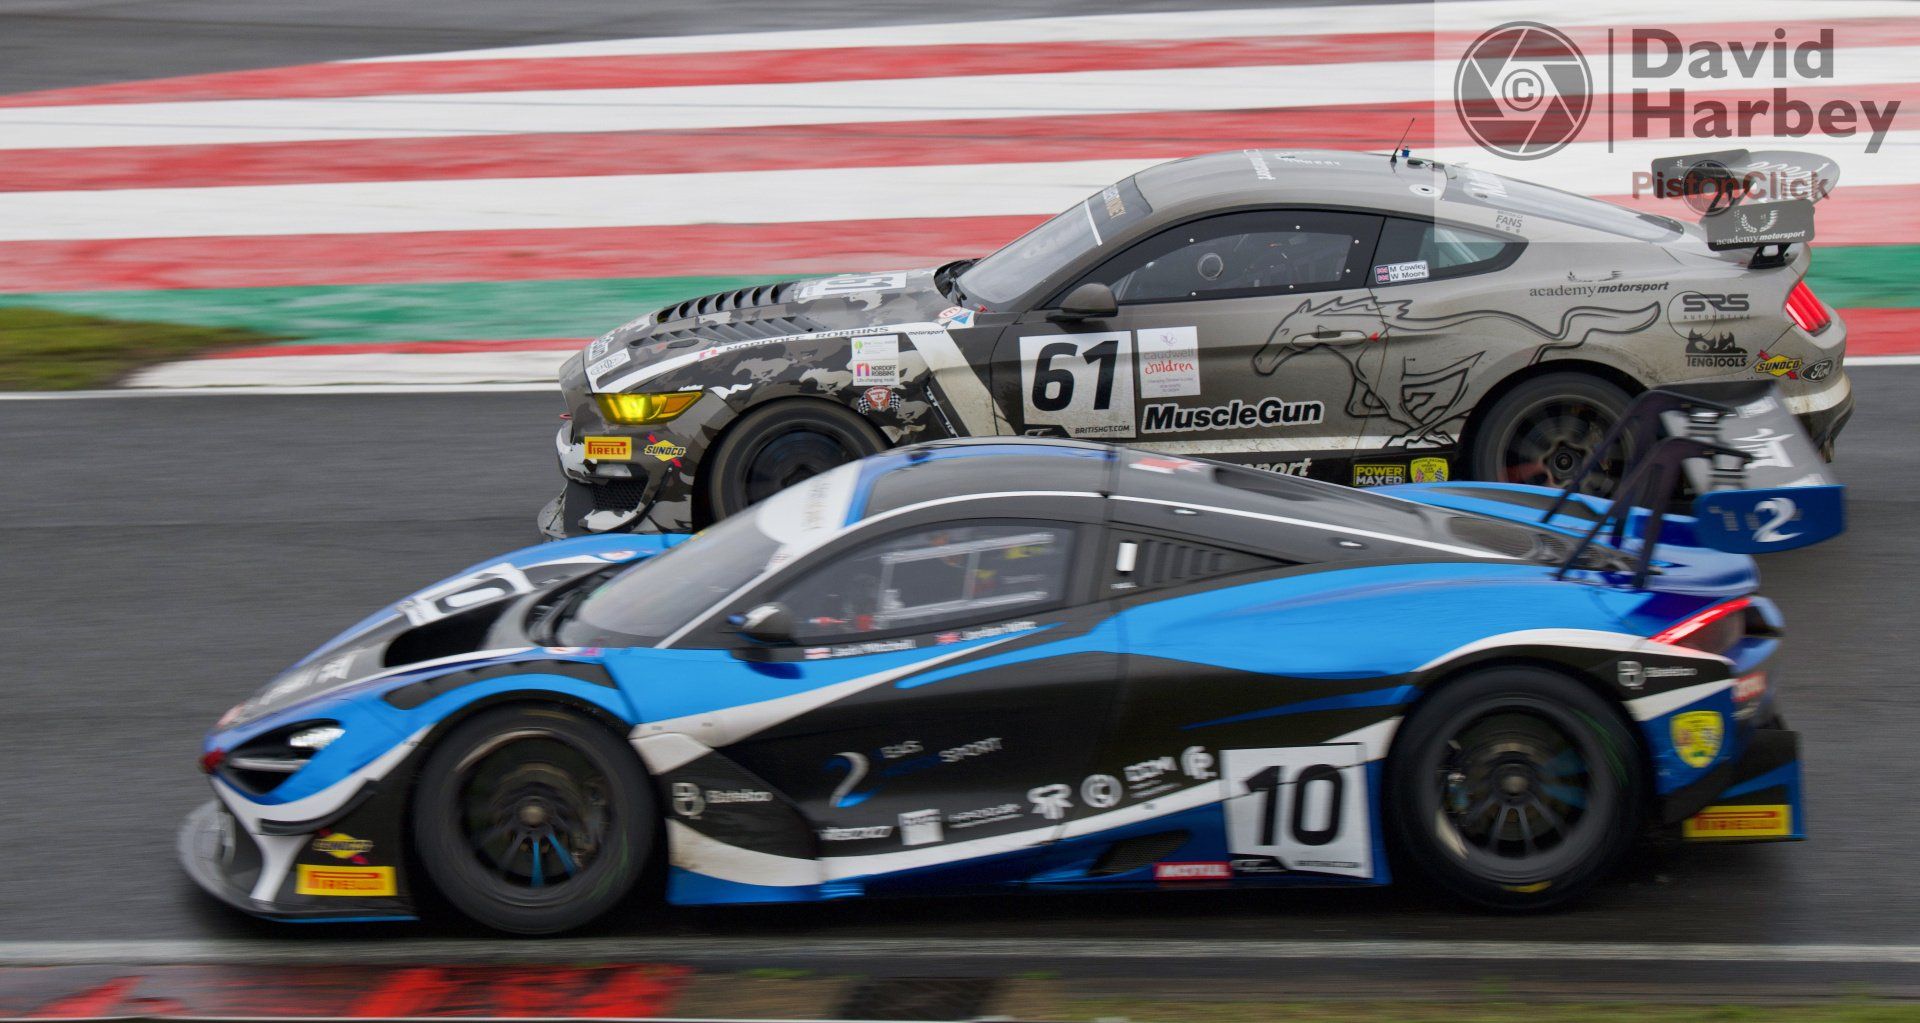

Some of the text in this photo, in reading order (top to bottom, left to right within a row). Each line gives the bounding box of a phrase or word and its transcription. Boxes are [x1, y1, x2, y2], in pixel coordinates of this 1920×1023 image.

[1496, 215, 1523, 228] FANS
[1683, 293, 1750, 312] SRS
[1144, 347, 1194, 359] caudwell
[1145, 360, 1194, 374] children
[1758, 360, 1801, 372] SUNOCO
[1811, 360, 1832, 379] Ford
[1032, 340, 1119, 412] 61
[1144, 399, 1322, 430] MuscleGun
[1075, 425, 1130, 434] BRITISHGT.COM
[588, 441, 626, 455] PIRELLI
[645, 446, 684, 456] SUNOCO
[1356, 466, 1402, 476] POWER
[1356, 476, 1402, 486] MAXED
[1752, 498, 1804, 543] 2
[1245, 763, 1344, 846] 10
